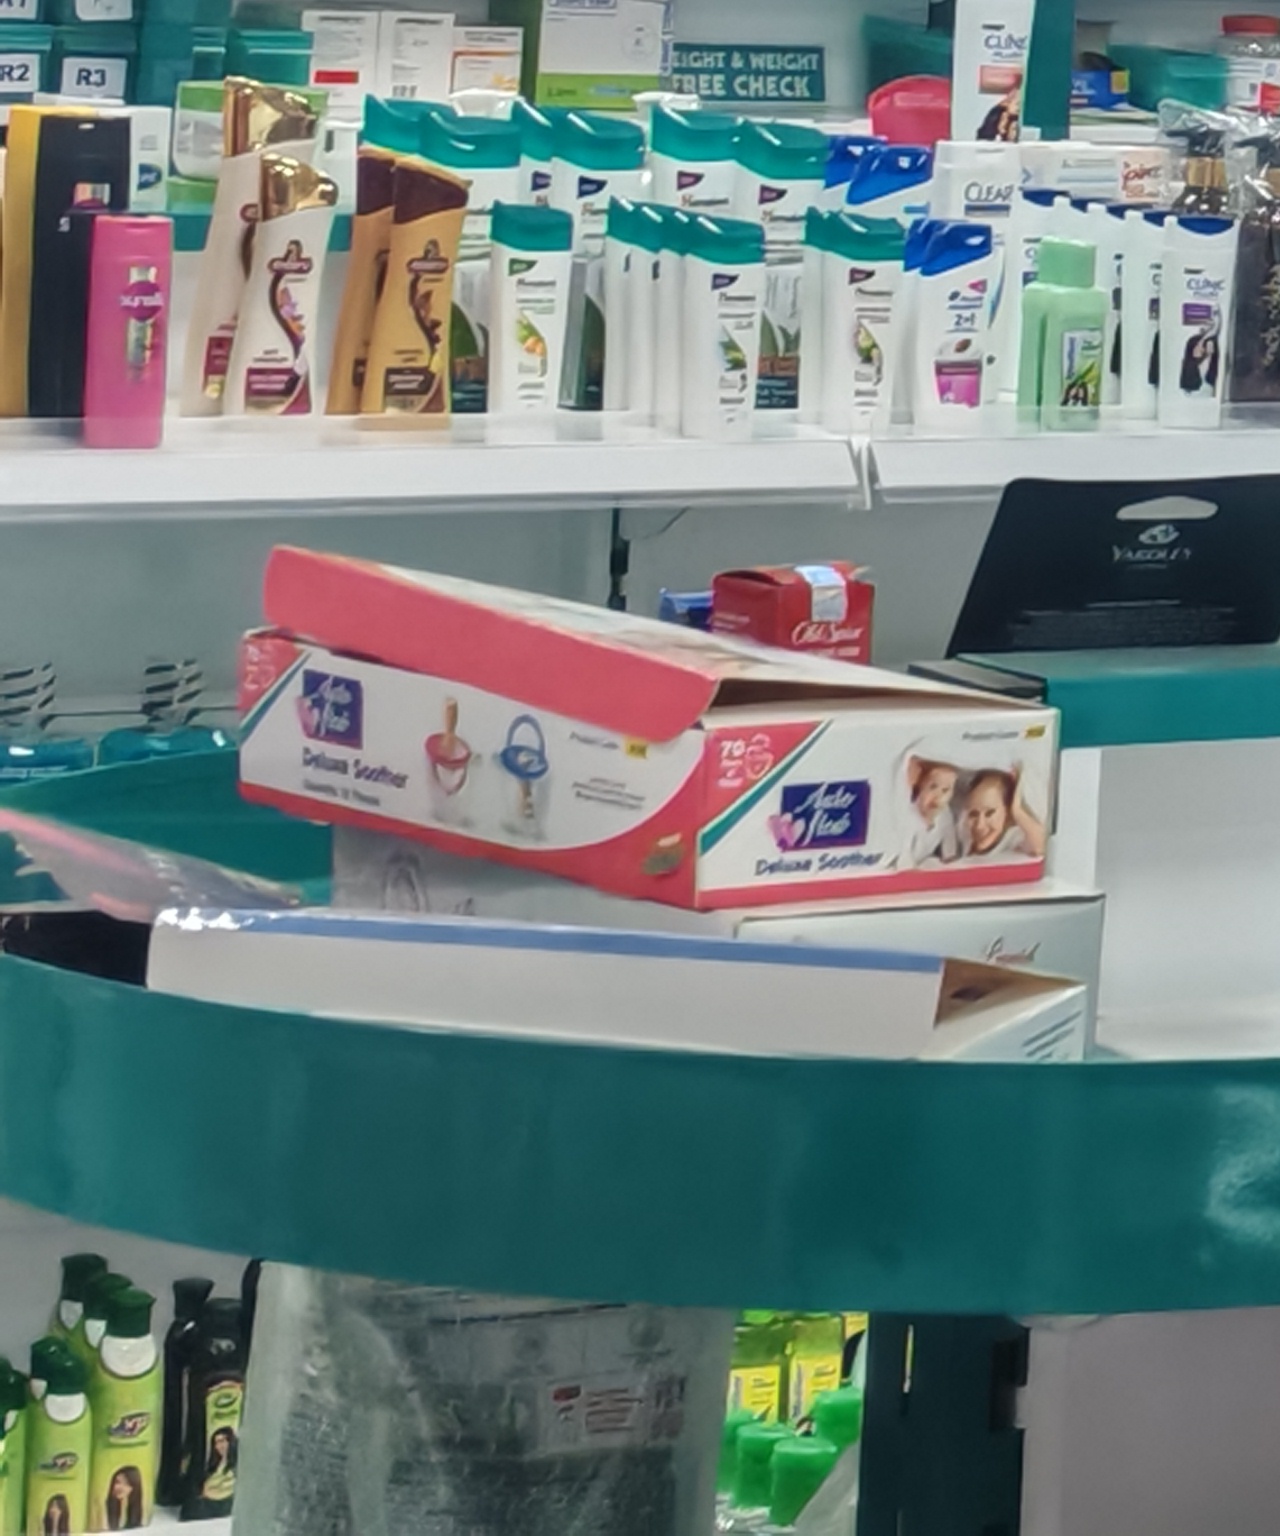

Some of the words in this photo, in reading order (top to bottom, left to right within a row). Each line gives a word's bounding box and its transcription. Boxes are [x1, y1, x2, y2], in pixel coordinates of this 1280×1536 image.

[731, 51, 744, 69] &
[750, 52, 819, 71] WEIGHT
[75, 67, 107, 88] R3
[672, 73, 727, 96] FREE
[733, 74, 811, 98] CHECK
